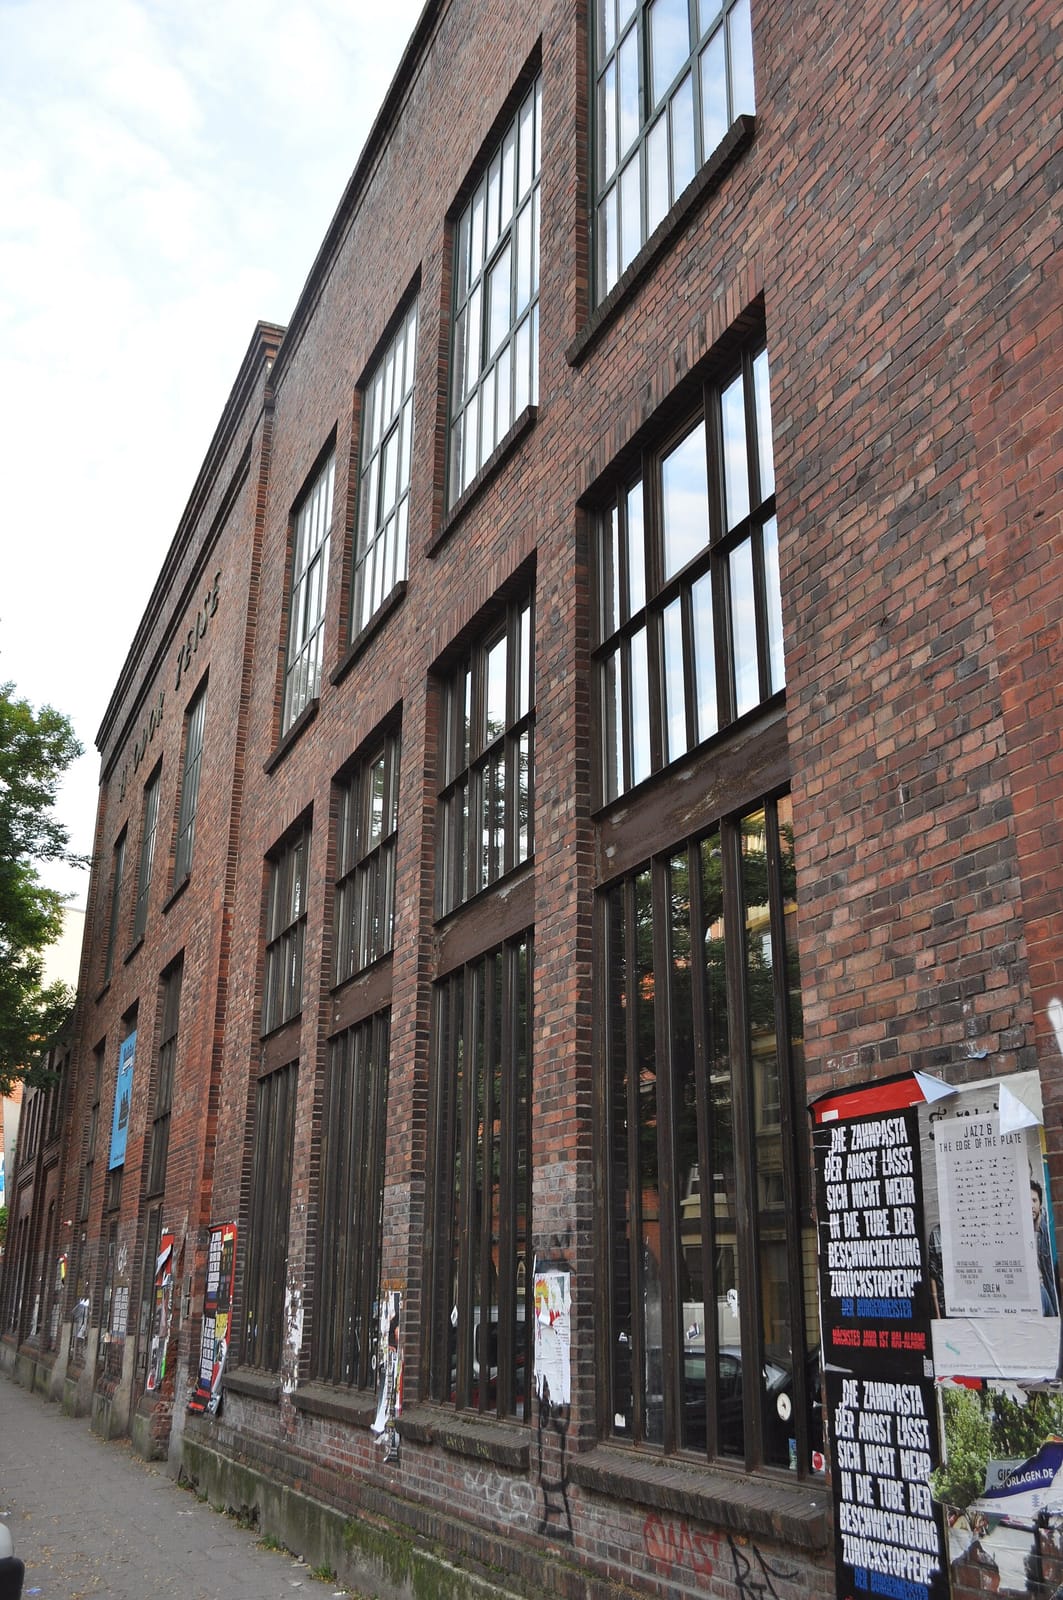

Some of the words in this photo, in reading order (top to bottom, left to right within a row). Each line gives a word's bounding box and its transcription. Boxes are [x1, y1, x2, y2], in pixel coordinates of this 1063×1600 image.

[851, 1117, 908, 1150] ZAHNPASTA
[939, 1142, 952, 1152] THE
[956, 1139, 971, 1150] EDGE
[975, 1138, 982, 1148] OF
[984, 1137, 996, 1147] THE
[1001, 1133, 1022, 1145] PLATE
[964, 1124, 984, 1138] JAZZ
[824, 1156, 842, 1182] DER
[846, 1151, 877, 1180] ANGST
[826, 1184, 848, 1211] SICH
[851, 1180, 880, 1209] NICHT
[885, 1177, 915, 1206] MEHR
[829, 1212, 840, 1239] IN
[844, 1211, 860, 1238] DIE
[863, 1208, 890, 1237] TUBE
[894, 1207, 915, 1235] DER
[828, 1238, 921, 1268] BESCHWICHTIGUNG
[841, 1298, 854, 1318] DER
[863, 1330, 877, 1347] JAHR
[879, 1331, 888, 1348] IST
[863, 1380, 924, 1416] ZAHNPASTA
[835, 1408, 854, 1438] DER
[859, 1411, 891, 1444] ANGST
[837, 1440, 861, 1470] SICH
[864, 1444, 896, 1477] NICHT
[900, 1448, 931, 1481] MEHR
[841, 1471, 852, 1500] IN
[856, 1473, 874, 1505] DIE
[878, 1478, 905, 1512] TUBE
[909, 1483, 932, 1517] DER
[840, 1502, 939, 1553] BESCHWICHTIGUNG
